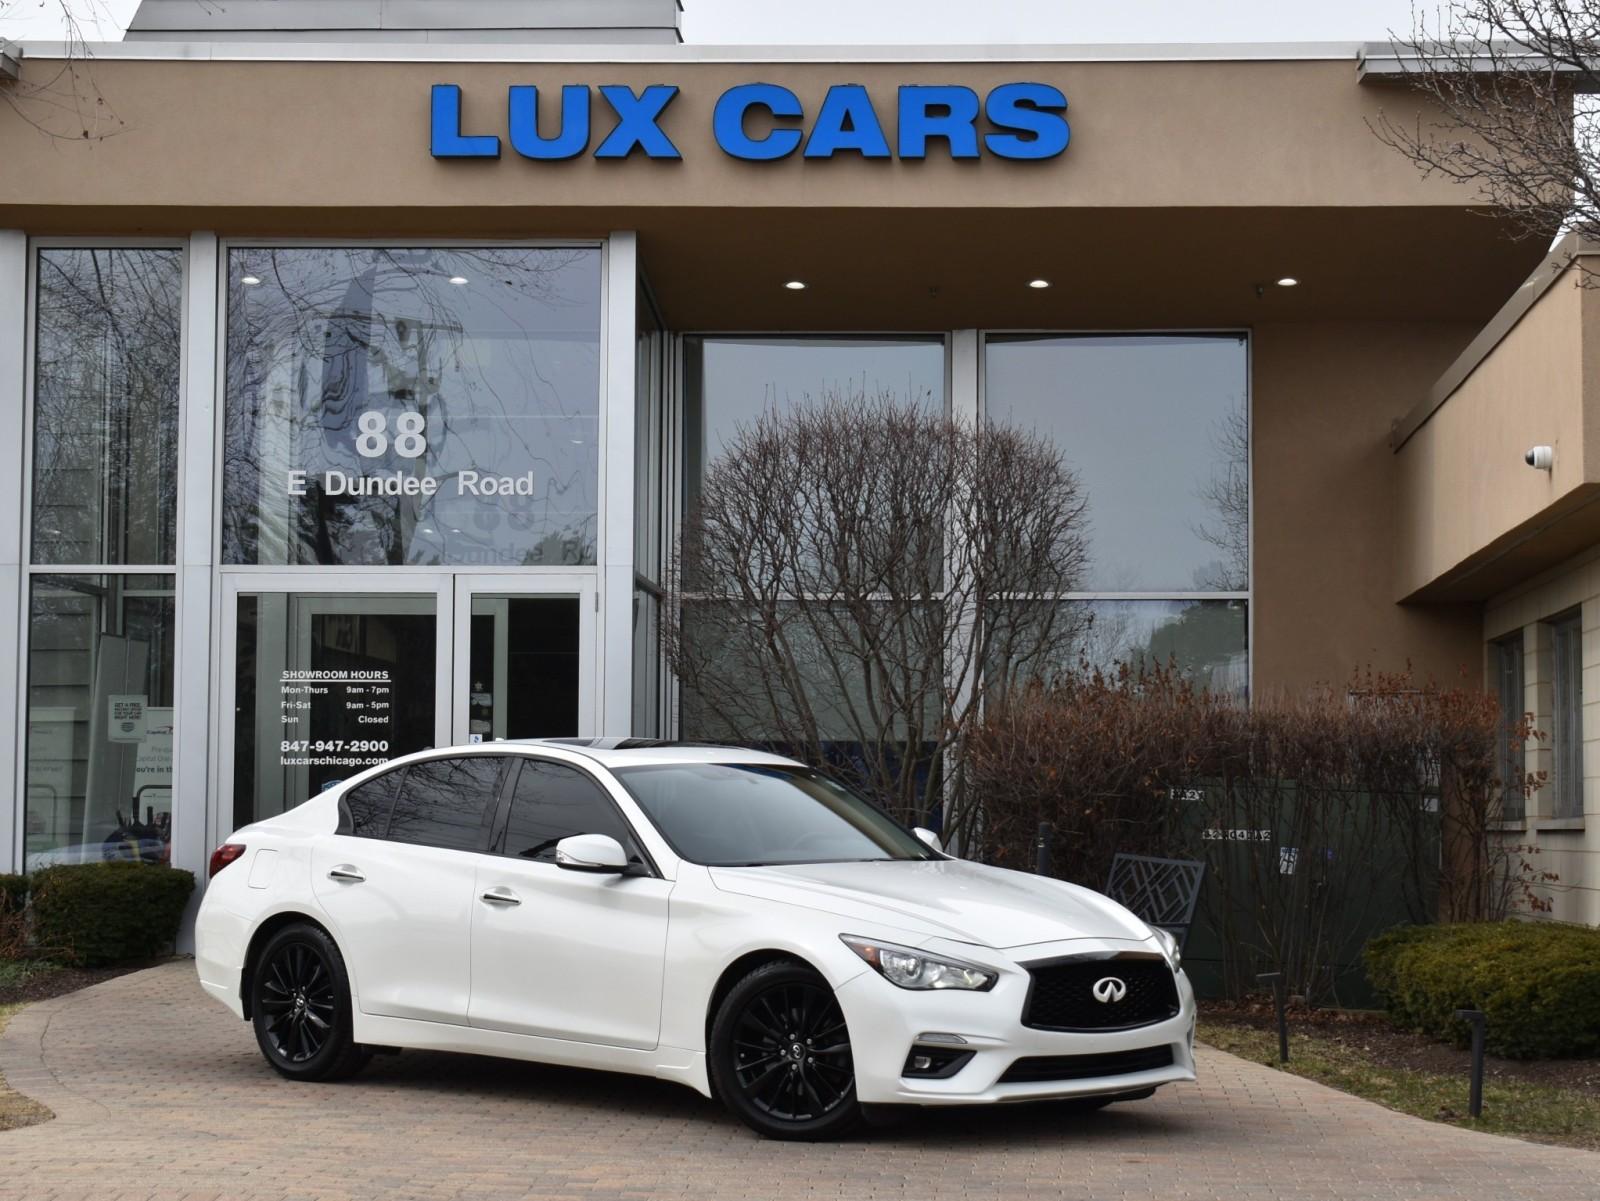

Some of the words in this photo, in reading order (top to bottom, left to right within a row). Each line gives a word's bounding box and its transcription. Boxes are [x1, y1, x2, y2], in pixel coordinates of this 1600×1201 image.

[430, 83, 683, 161] LUX
[713, 81, 1071, 161] CARS
[355, 411, 427, 458] 88
[287, 470, 307, 496] E
[325, 470, 437, 497] Dundee
[457, 470, 535, 496] Road
[282, 670, 348, 679] SHOWROOM
[350, 670, 389, 679] HOURS
[281, 686, 329, 694] Mon-Thurs
[346, 686, 364, 694] 9am
[371, 686, 390, 695] 7pm
[281, 701, 311, 709] Fri-Sat
[371, 701, 390, 710] 5pm
[281, 715, 299, 723] Sun
[358, 715, 389, 723] Closed
[280, 740, 389, 752] 847-947-2900
[280, 756, 389, 767] luxcarschicago.com
